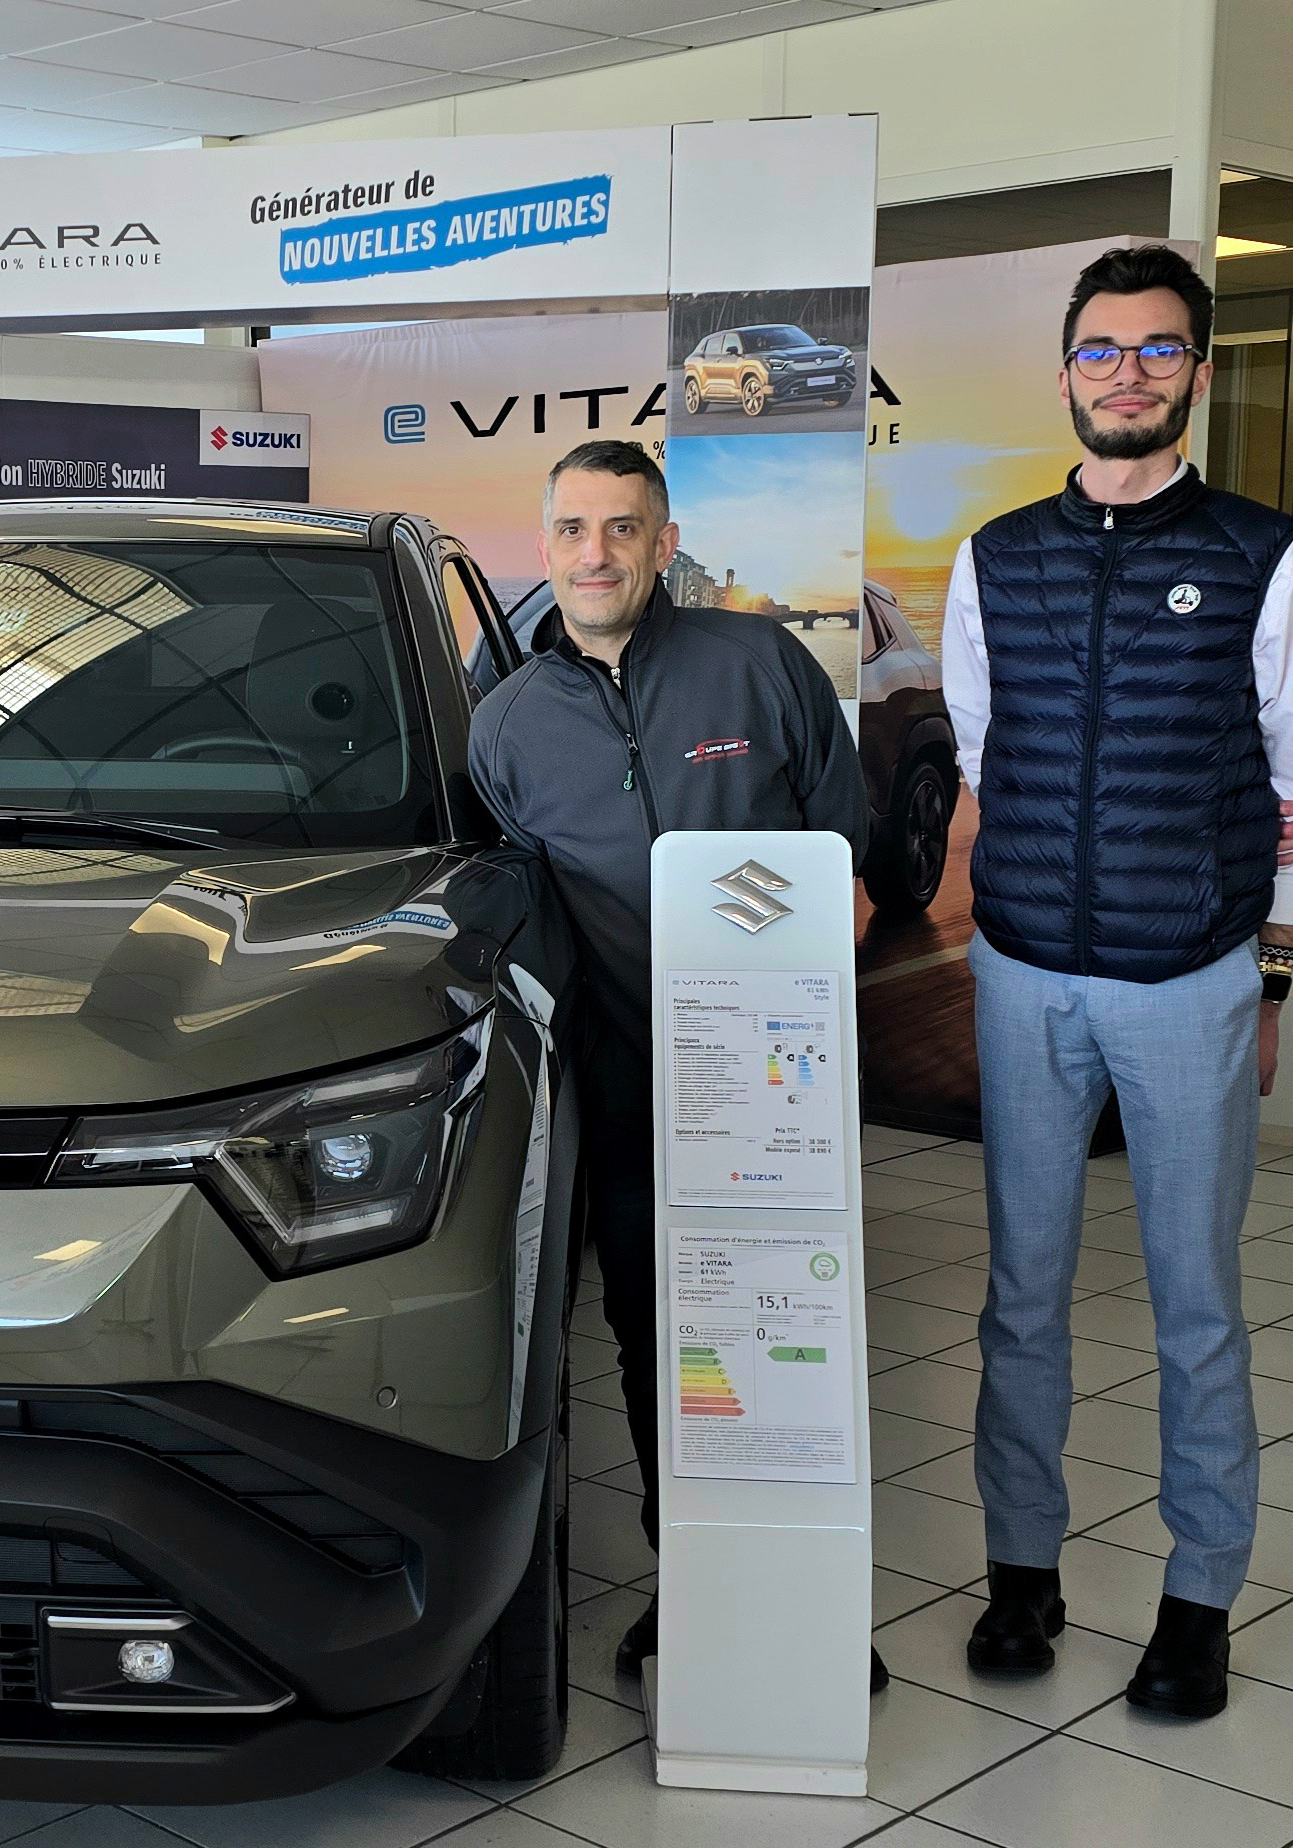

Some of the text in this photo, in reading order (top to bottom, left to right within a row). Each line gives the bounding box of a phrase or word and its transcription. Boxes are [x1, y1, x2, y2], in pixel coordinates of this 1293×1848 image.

[250, 169, 435, 225] Générateur de
[283, 192, 608, 273] NOUVELLES AVENTURES
[38, 253, 162, 270] ÉLECTRIQUE
[450, 364, 902, 439] VITAA
[232, 431, 301, 449] SUZUKI
[28, 459, 107, 489] HYBRIDE
[111, 463, 166, 490] Suzuki
[742, 1173, 783, 1181] SUZUKI
[680, 1235, 730, 1243] Consommation
[731, 1236, 763, 1245] d'énergie
[772, 1238, 802, 1246] émission
[700, 1250, 726, 1258] SUZUKI
[710, 1268, 727, 1276] kWh
[678, 1287, 730, 1296] Consommation
[678, 1294, 713, 1303] électrique
[757, 1295, 789, 1311] 15,1
[756, 1327, 766, 1341] 0
[795, 1348, 806, 1361] A
